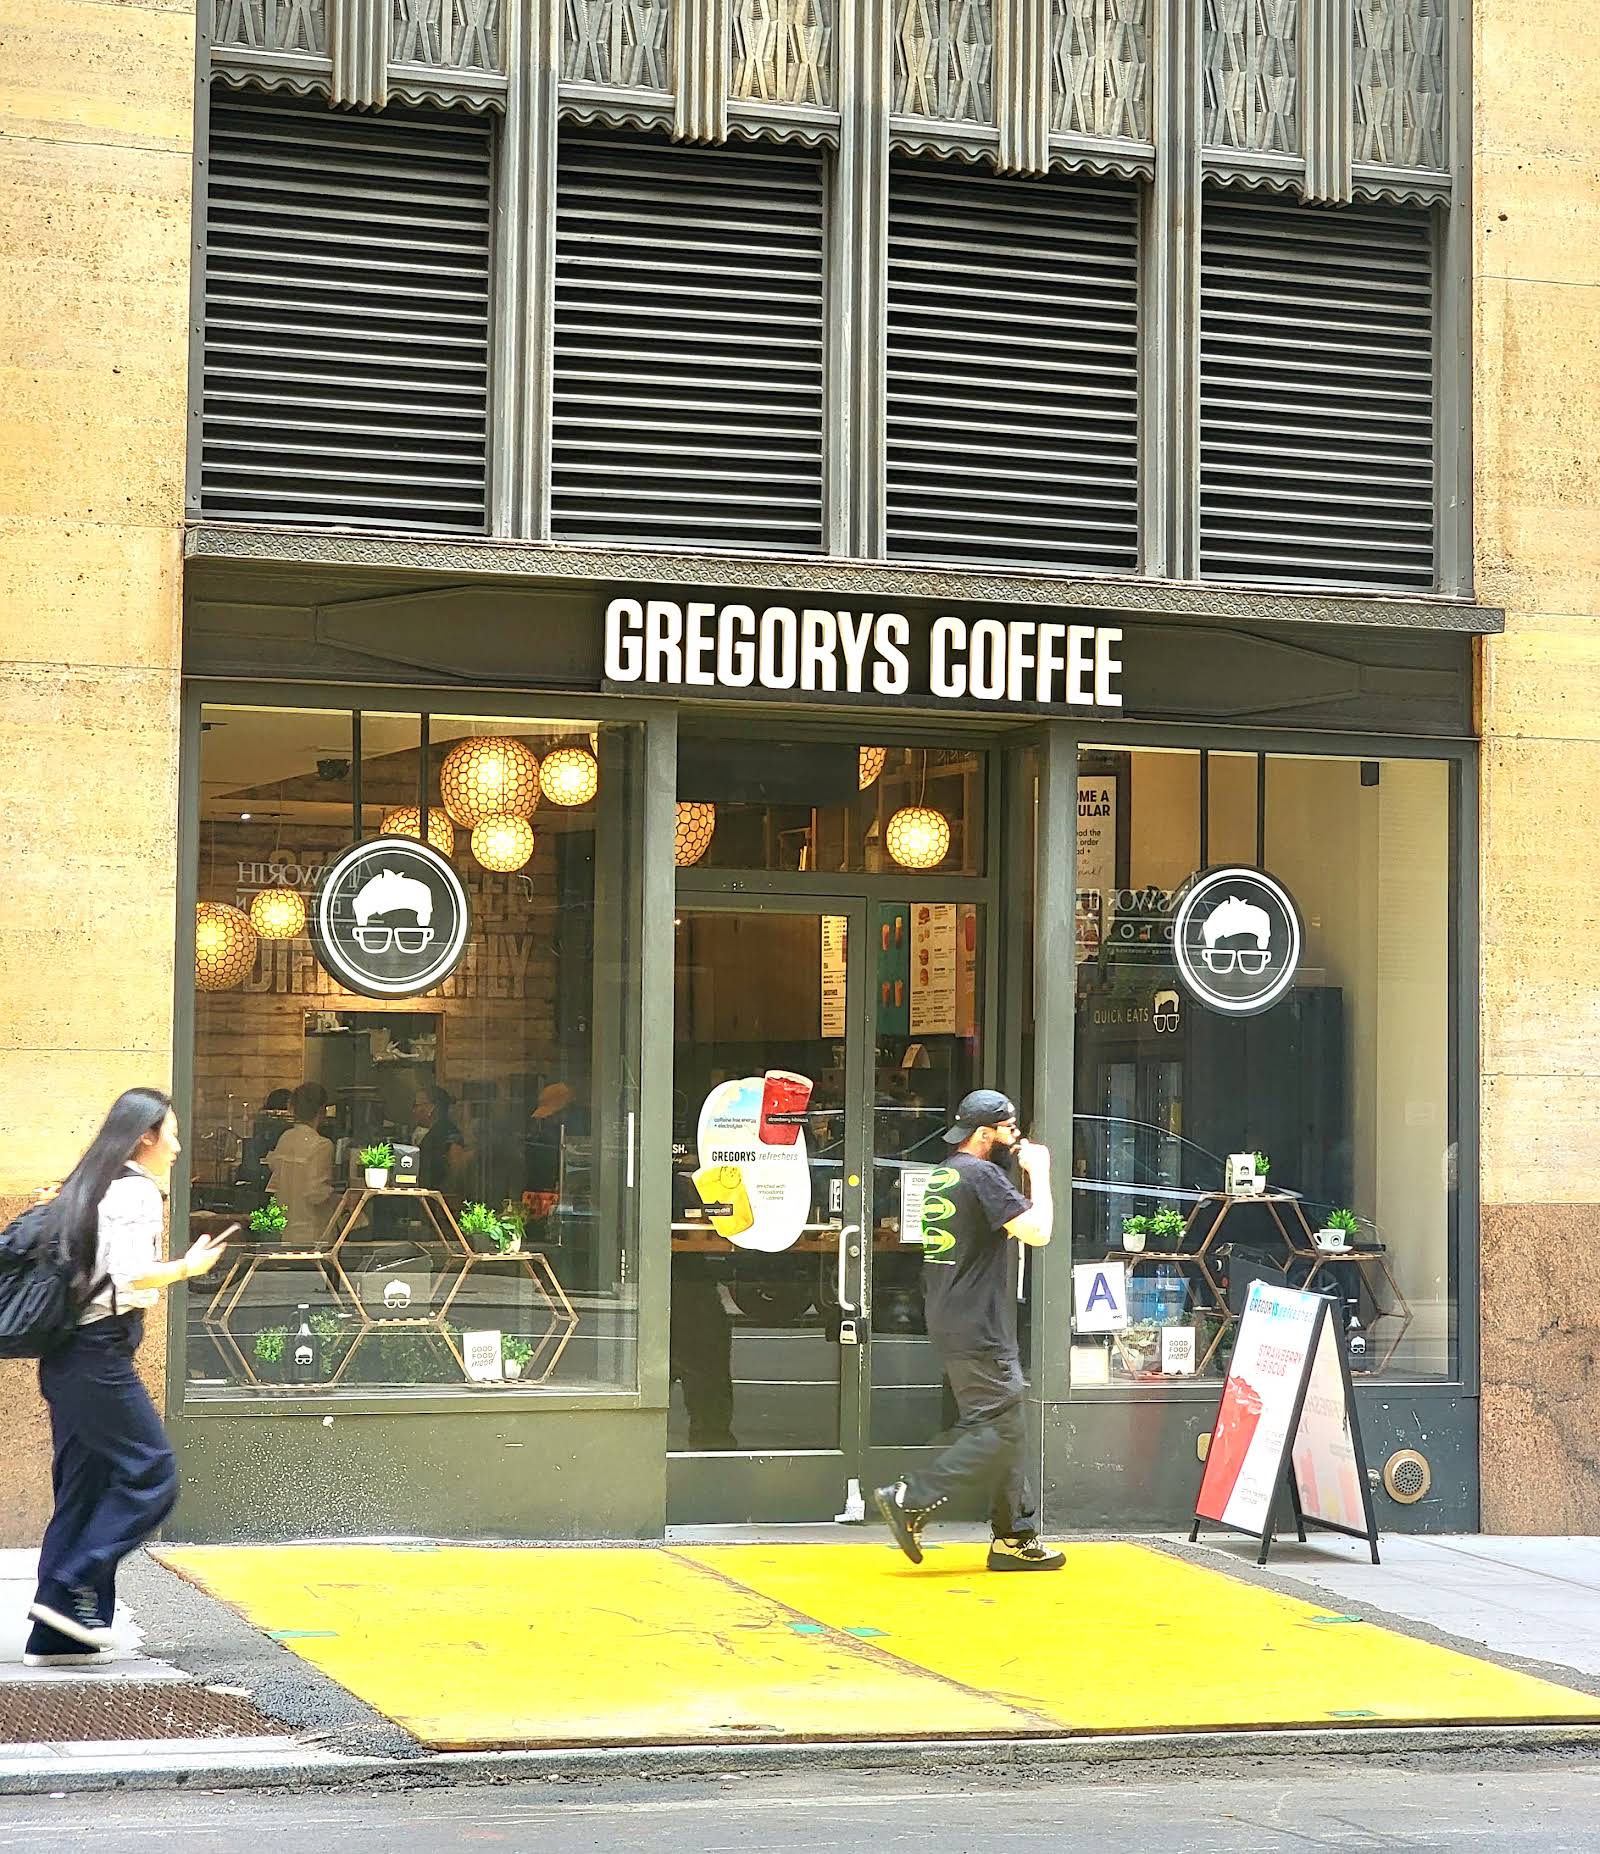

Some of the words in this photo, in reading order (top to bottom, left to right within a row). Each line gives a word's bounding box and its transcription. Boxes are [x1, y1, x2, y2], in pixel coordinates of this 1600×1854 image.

[604, 598, 909, 695] GREGORYS
[930, 616, 1123, 707] COFFEE
[1077, 790, 1097, 802] ME
[1100, 789, 1110, 802] A
[1078, 804, 1111, 817] ULAR
[1089, 828, 1102, 837] the
[1079, 837, 1099, 846] order
[1094, 1008, 1123, 1024] QUICK
[1126, 1007, 1149, 1023] EATS
[712, 1151, 756, 1162] GREGORYS
[758, 1151, 799, 1161] refreshers
[1085, 1272, 1118, 1312] A
[1249, 1297, 1280, 1317] GREGORYS
[1258, 1344, 1304, 1364] STRAWBERRY
[1256, 1358, 1287, 1377] HIBISCUS
